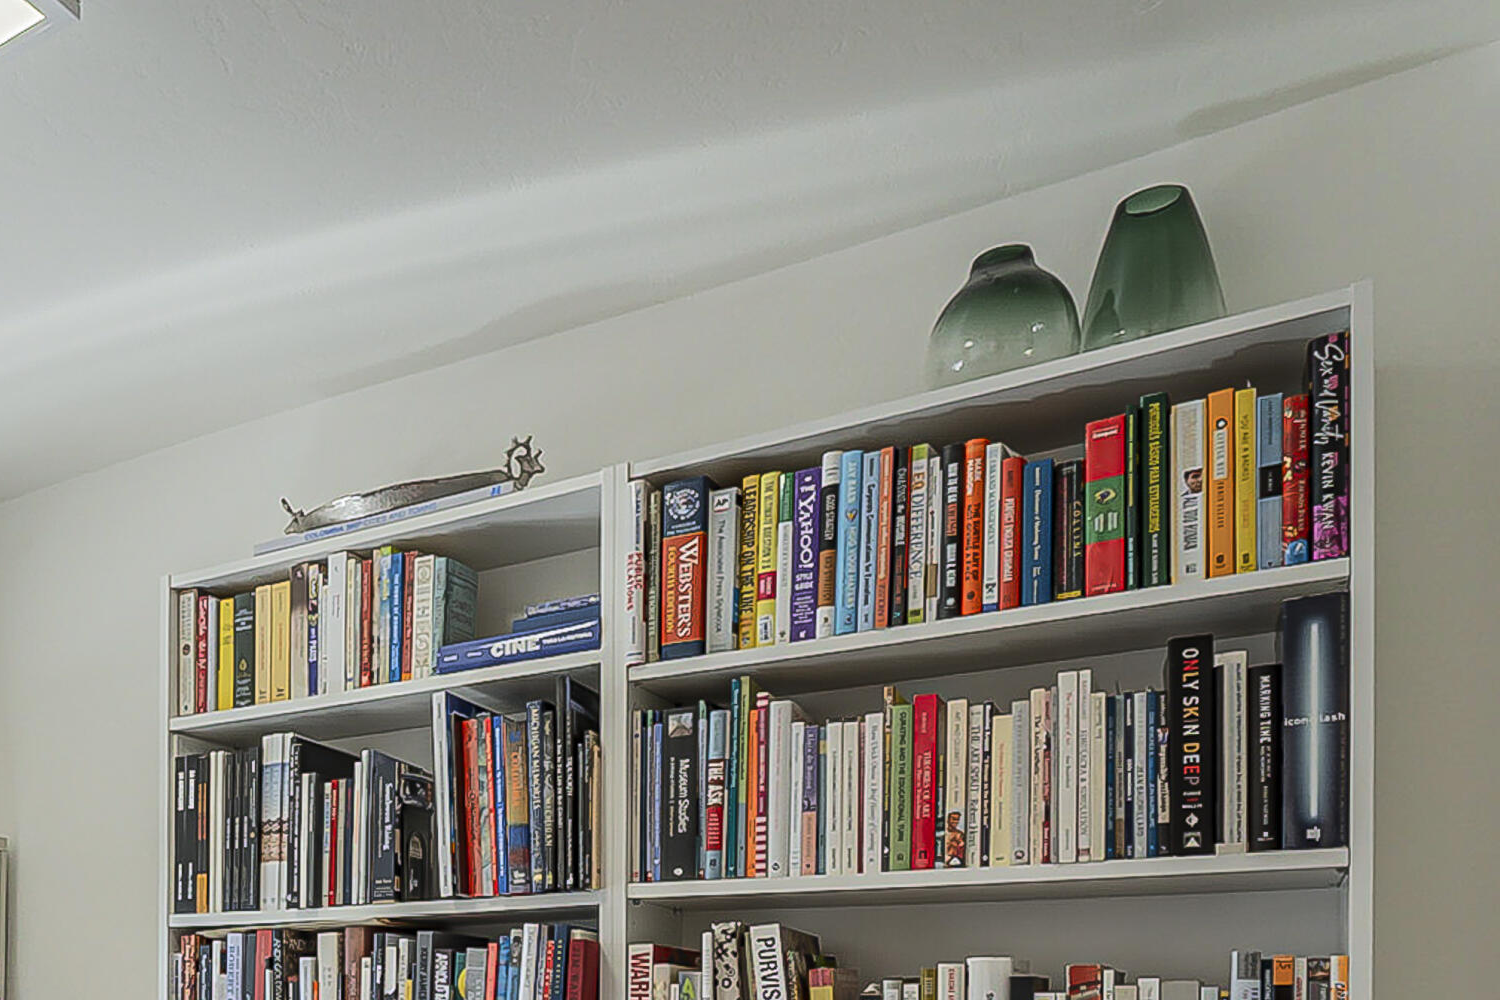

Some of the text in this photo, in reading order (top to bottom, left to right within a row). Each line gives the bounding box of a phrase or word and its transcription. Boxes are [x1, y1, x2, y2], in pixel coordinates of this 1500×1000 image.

[1314, 343, 1344, 375] Sex
[1314, 399, 1344, 445] Vanity
[1321, 452, 1334, 488] KEVIN
[909, 472, 925, 578] EQ DIFFERENCE
[1322, 493, 1334, 530] KWAN
[633, 552, 644, 590] PUBLIC
[741, 485, 757, 614] LEADERSHIP ON THE LINE
[626, 552, 635, 611] RELATIONS
[666, 546, 677, 634] FOURTH EDITION
[676, 536, 699, 638] WEBSTER'S
[714, 519, 726, 633] The Associated Press Stylebook
[490, 636, 540, 658] CINE
[531, 708, 541, 758] MICHIGAN
[1182, 648, 1200, 786] ONLY SKIN DEEP
[1259, 675, 1271, 744] MARKING TIME
[677, 758, 691, 833] Museum Studies
[706, 762, 725, 807] THE ASK
[896, 711, 908, 841] CURATING EDUCATIONAL TURN
[967, 725, 980, 847] THE ART Robert Henri
[227, 946, 235, 995] ROBERT
[419, 946, 428, 973] KERRY
[434, 952, 448, 992] ARNOLD
[419, 974, 428, 1000] JAMES
